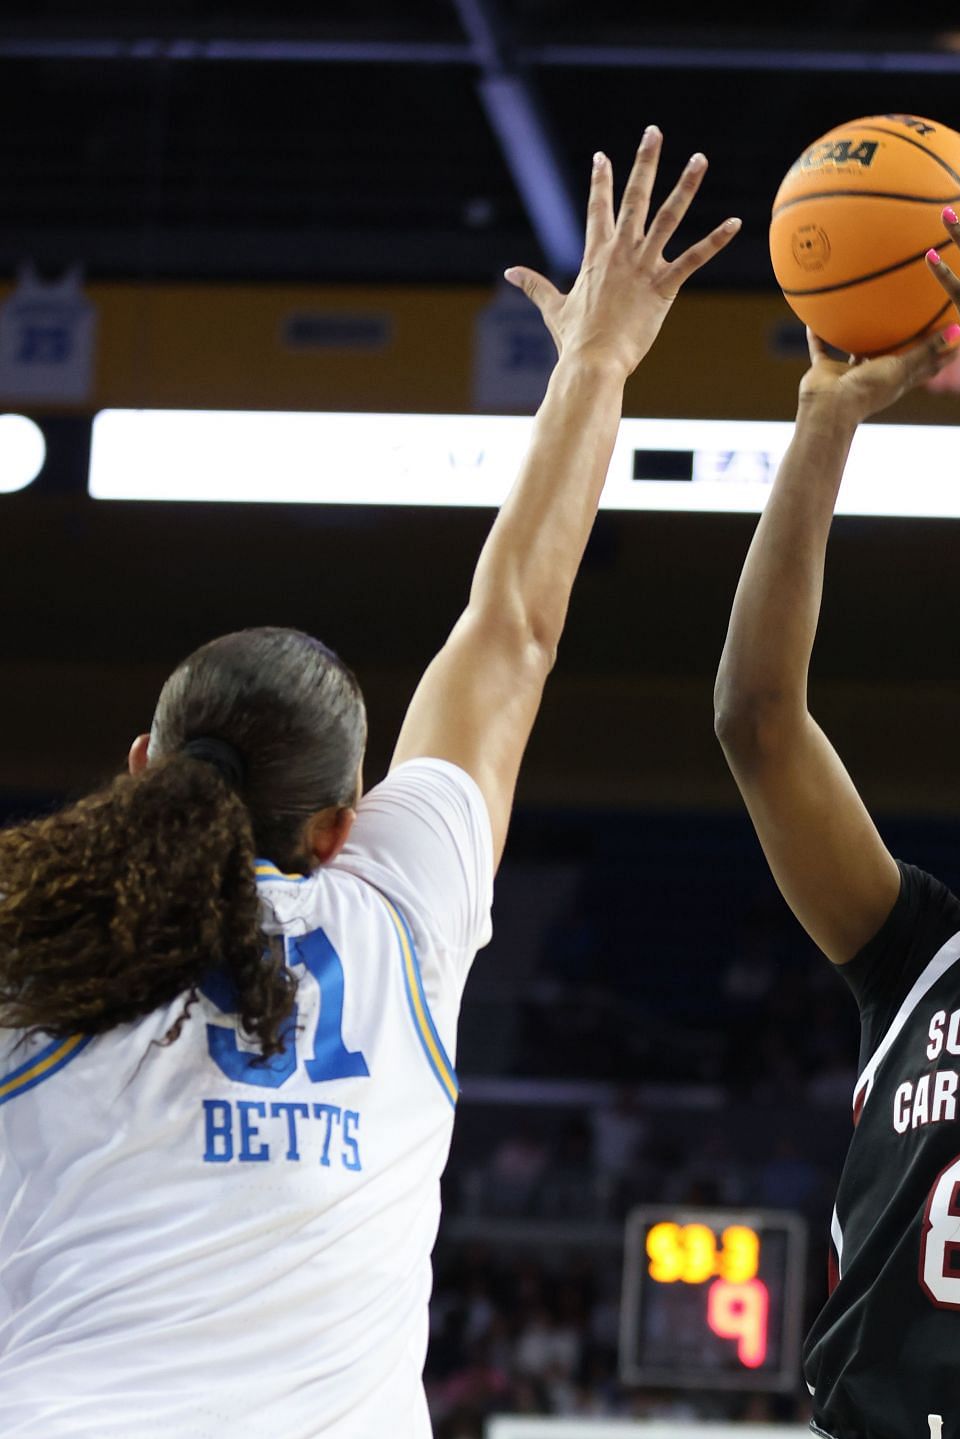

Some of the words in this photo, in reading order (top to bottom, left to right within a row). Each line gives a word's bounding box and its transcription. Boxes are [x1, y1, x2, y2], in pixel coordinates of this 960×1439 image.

[800, 141, 879, 168] CAA
[202, 1099, 362, 1172] BETTS
[708, 1277, 769, 1368] 9
